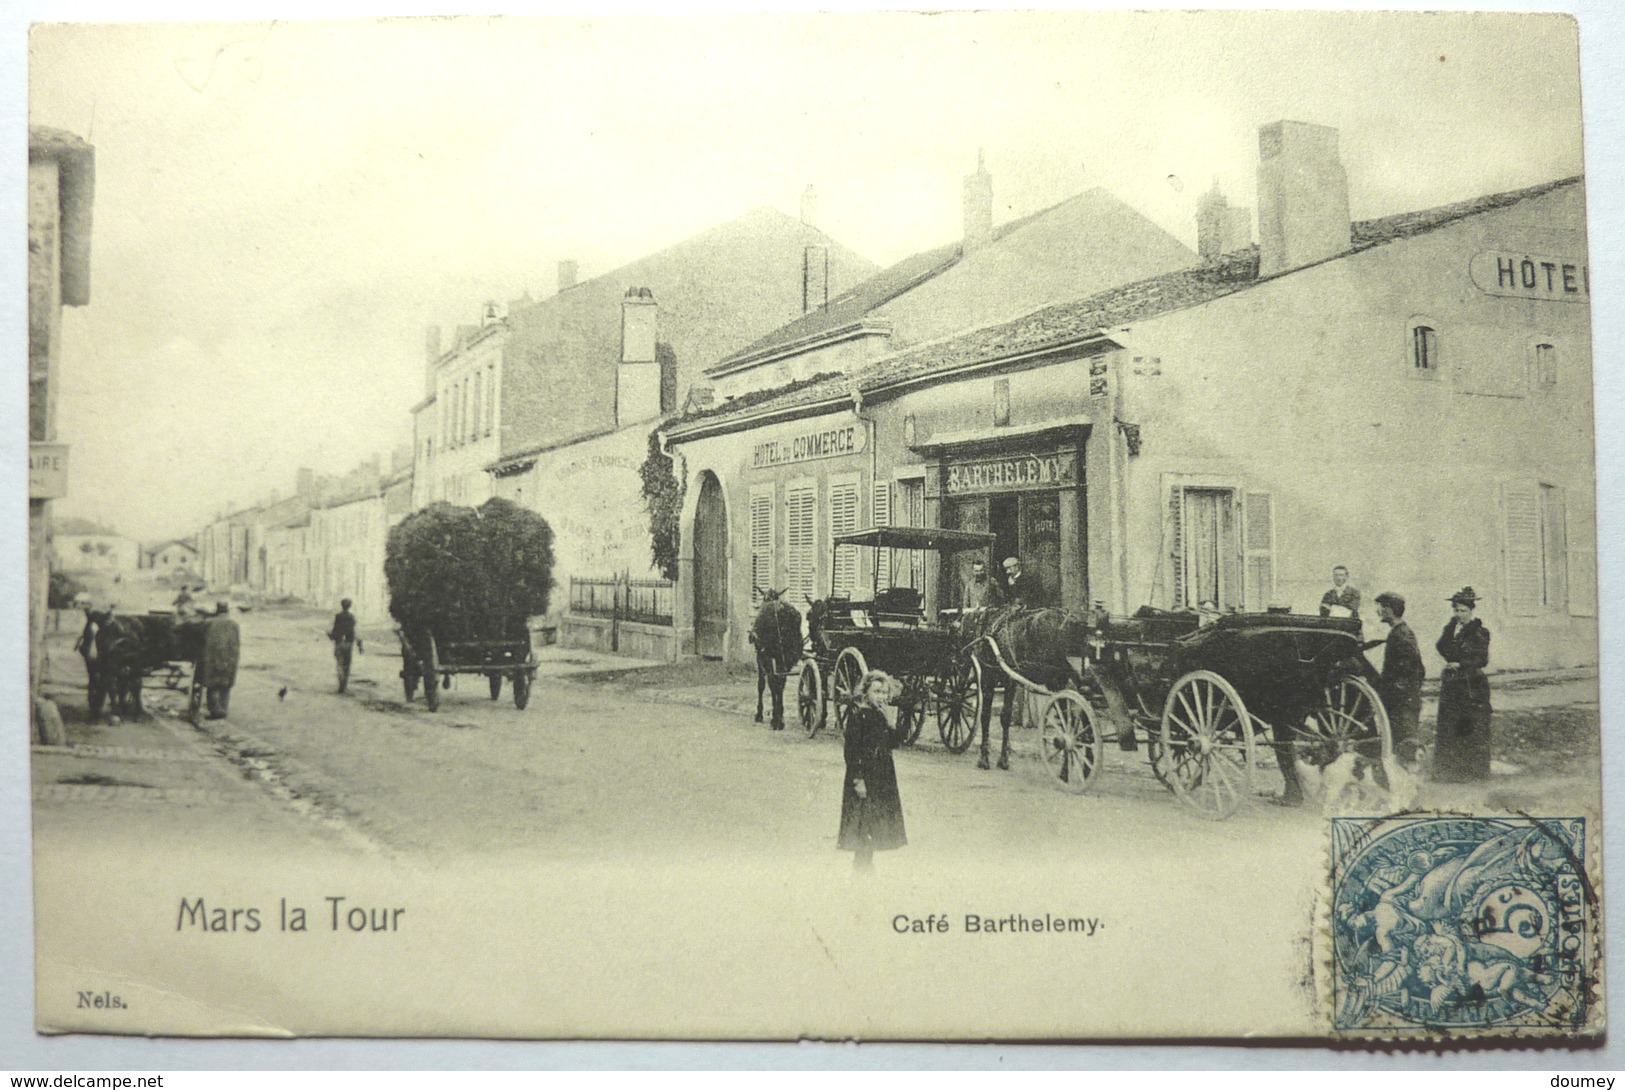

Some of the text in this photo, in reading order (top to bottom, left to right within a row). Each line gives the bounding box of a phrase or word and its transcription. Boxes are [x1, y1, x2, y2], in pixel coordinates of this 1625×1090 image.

[793, 427, 855, 459] COMMERCE
[176, 896, 406, 932] Mars la Tour
[892, 913, 1106, 937] Café Barthelemy.
[76, 990, 129, 1010] Nels.
